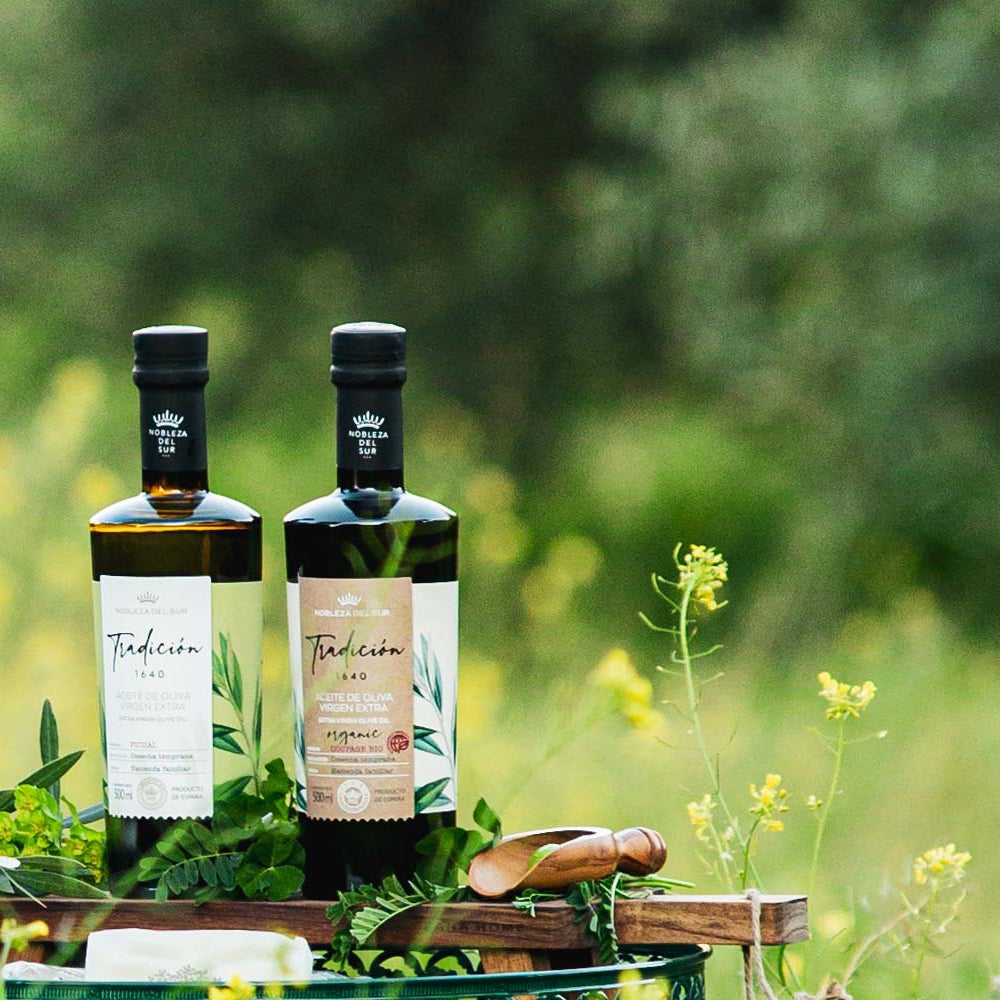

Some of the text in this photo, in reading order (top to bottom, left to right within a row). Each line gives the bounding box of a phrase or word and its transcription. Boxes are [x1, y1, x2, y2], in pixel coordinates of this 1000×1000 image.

[148, 428, 188, 438] NOBLEZA
[348, 430, 388, 438] NOBLEZA
[158, 437, 176, 445] DEL
[158, 446, 176, 454] SUR
[358, 447, 377, 455] SUR
[314, 609, 352, 617] NOBLEZA
[107, 628, 203, 672] Tradición
[305, 630, 406, 675] Tradición
[135, 669, 165, 678] 1640
[336, 672, 367, 680] 1640
[315, 692, 395, 702] ACEITE DE OLIVA
[319, 703, 388, 712] VIRGEN EXTRA
[326, 729, 382, 745] organic
